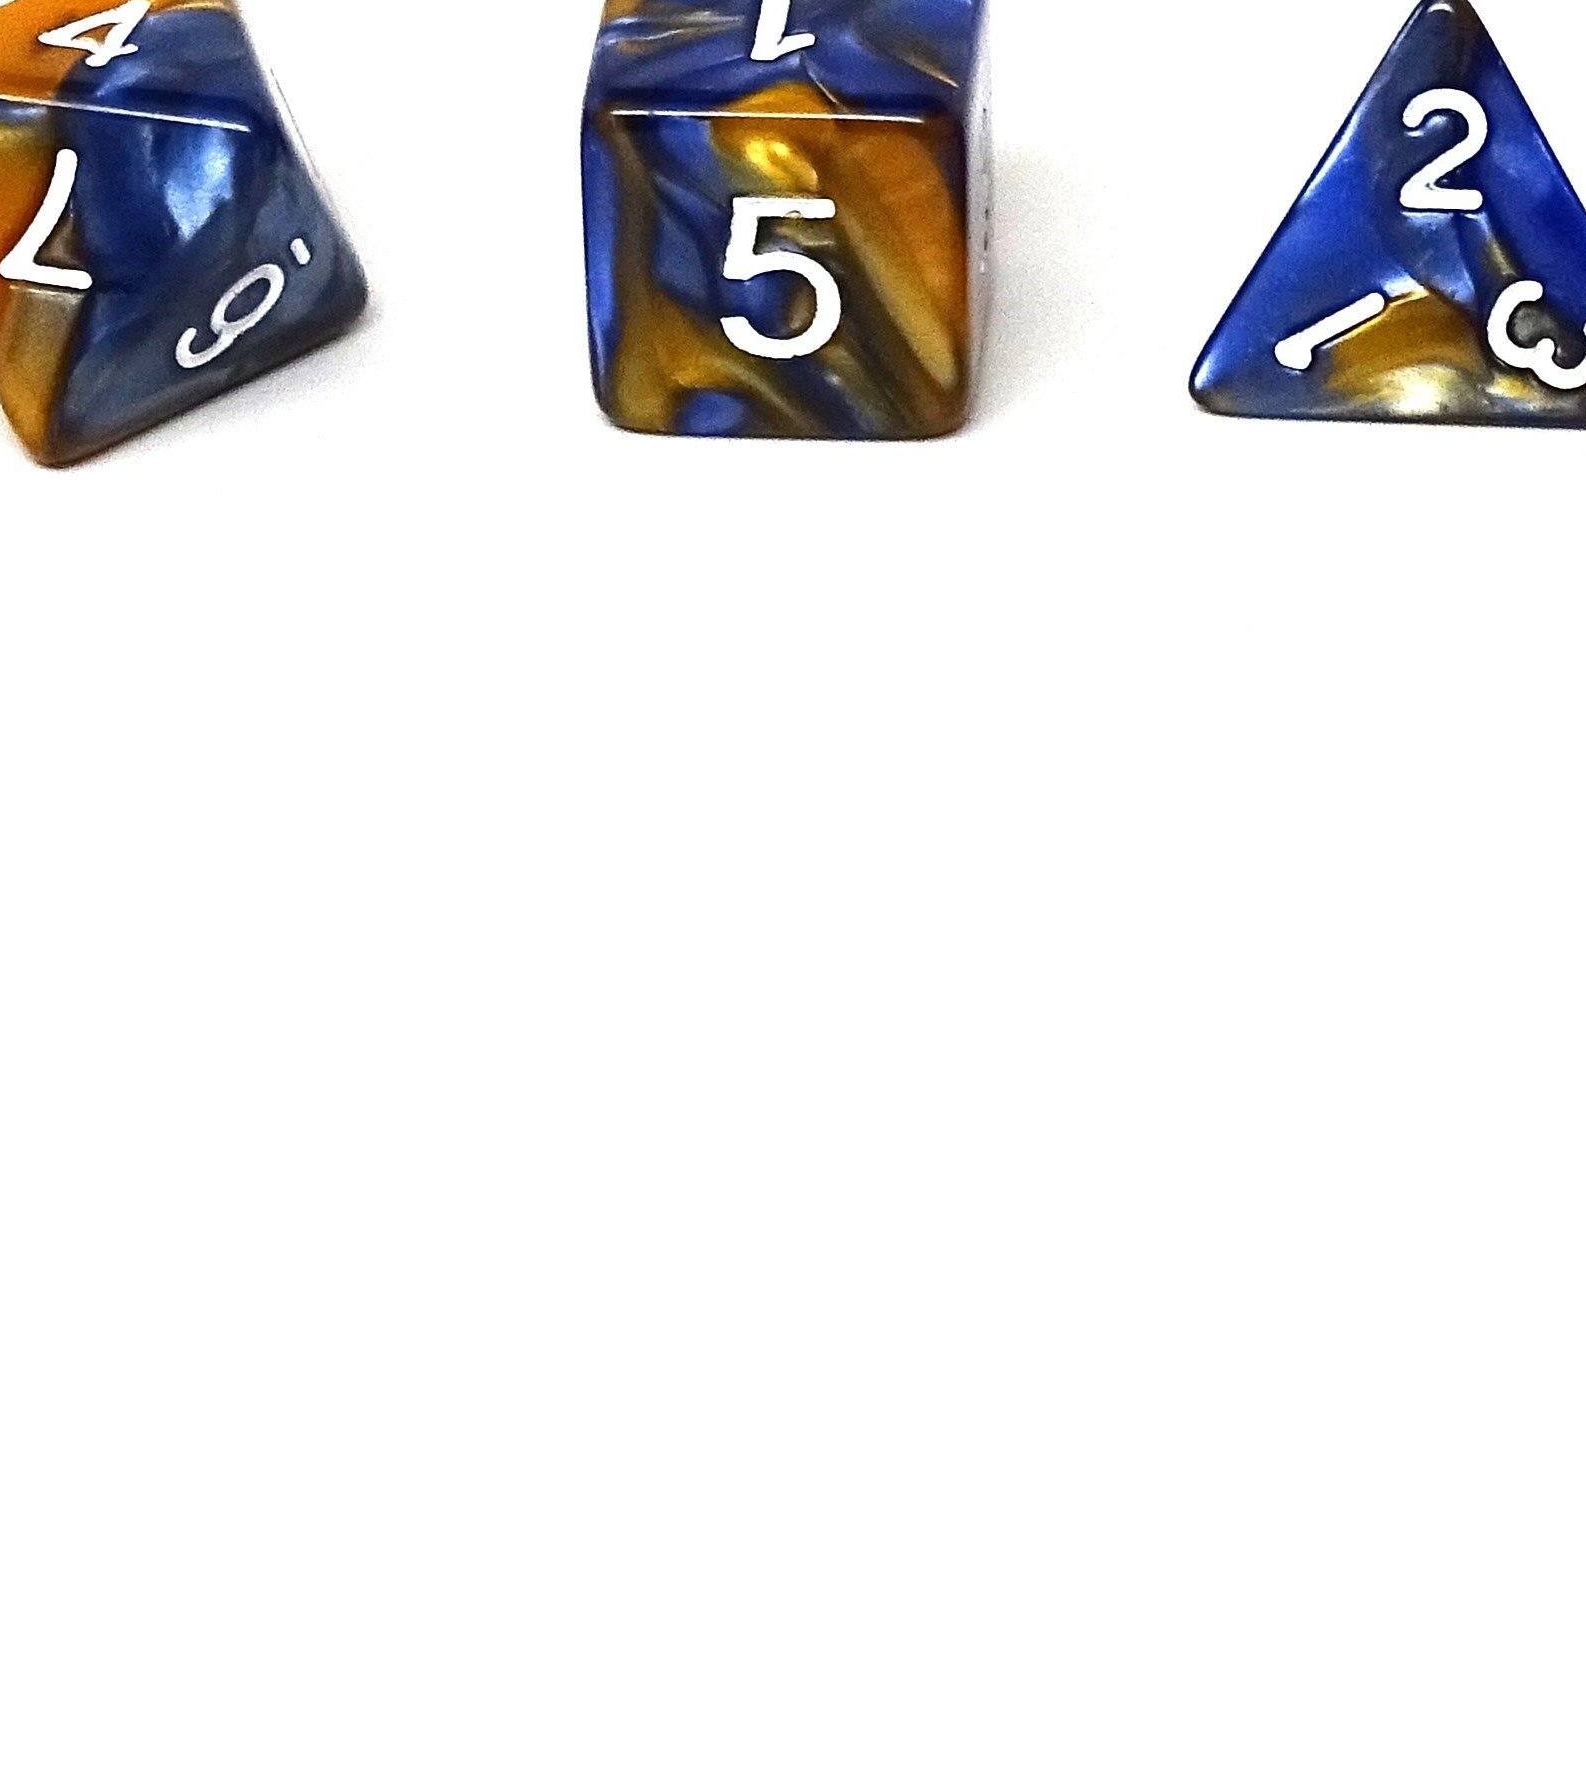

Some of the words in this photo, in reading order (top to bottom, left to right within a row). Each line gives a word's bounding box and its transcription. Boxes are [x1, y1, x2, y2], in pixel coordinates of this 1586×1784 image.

[1399, 88, 1488, 210] 2
[720, 196, 842, 359] 5
[1275, 292, 1385, 370] 1
